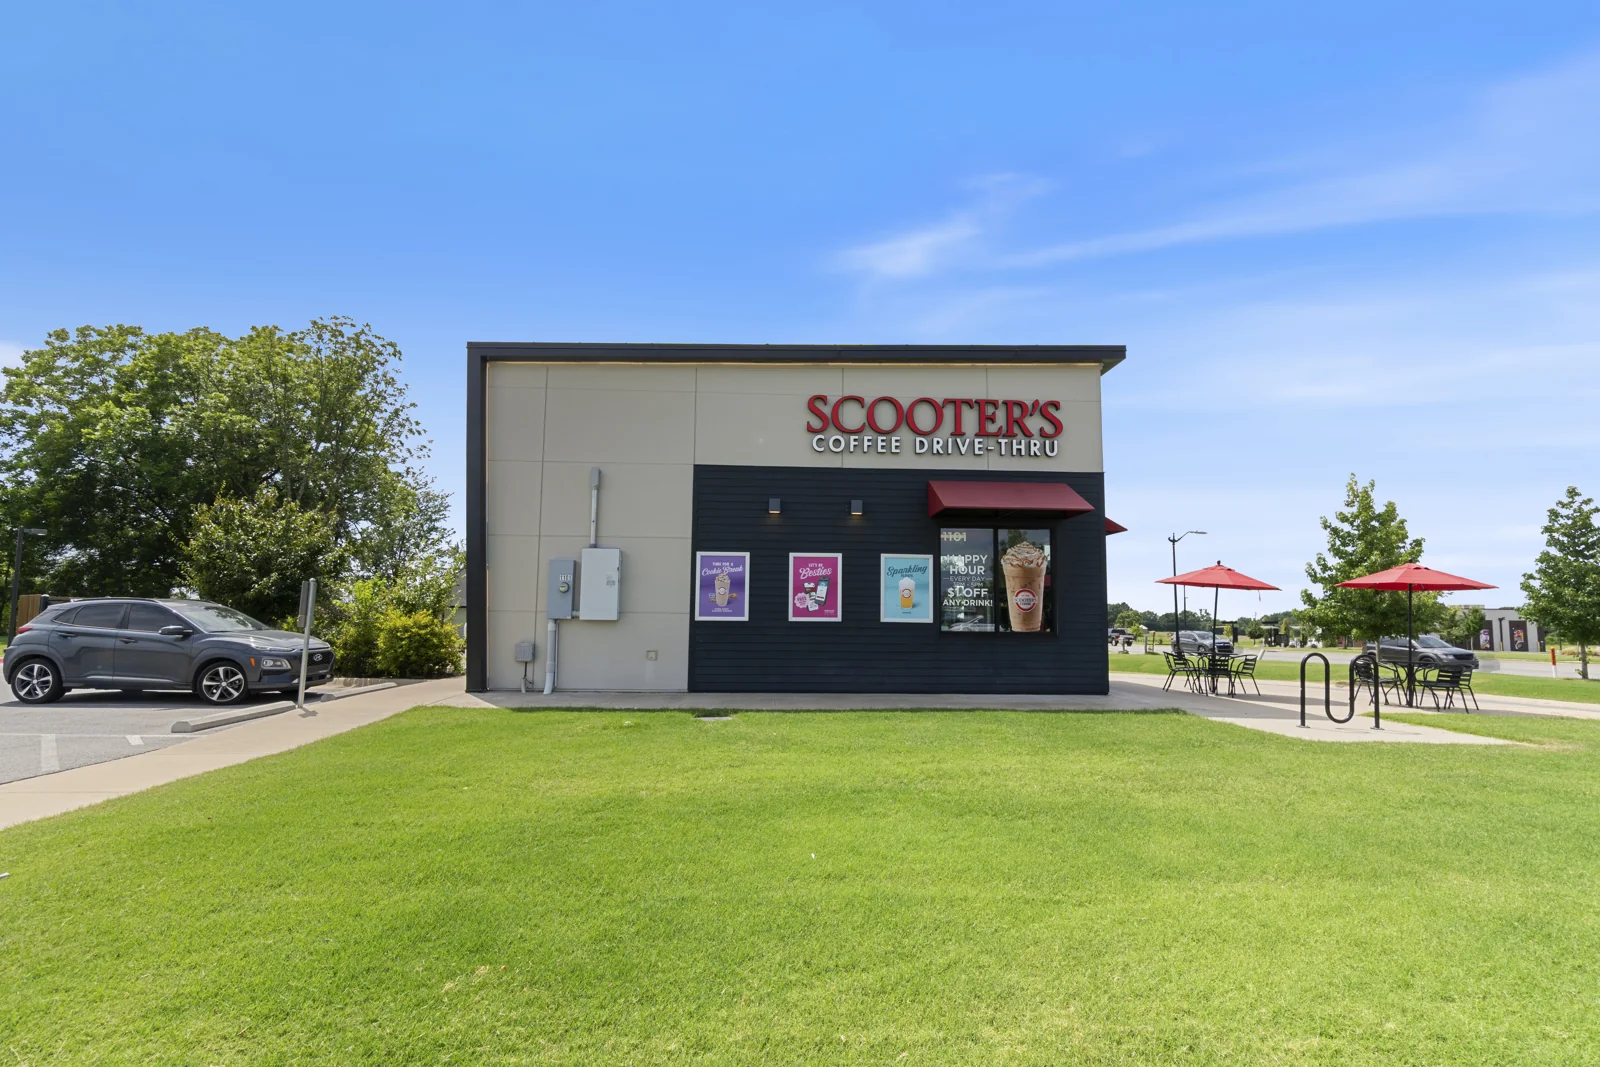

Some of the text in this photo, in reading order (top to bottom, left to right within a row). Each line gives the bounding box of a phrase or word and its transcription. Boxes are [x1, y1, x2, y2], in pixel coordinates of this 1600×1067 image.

[806, 394, 1064, 437] SCOOTER'S
[812, 435, 1059, 456] COFFEE DRIVE-THRU
[946, 554, 988, 564] HAPPY
[701, 564, 743, 576] Cookie Break
[799, 567, 832, 579] Besties
[886, 564, 928, 577] Sparkling
[950, 566, 985, 575] HOUR
[964, 588, 988, 598] OFF
